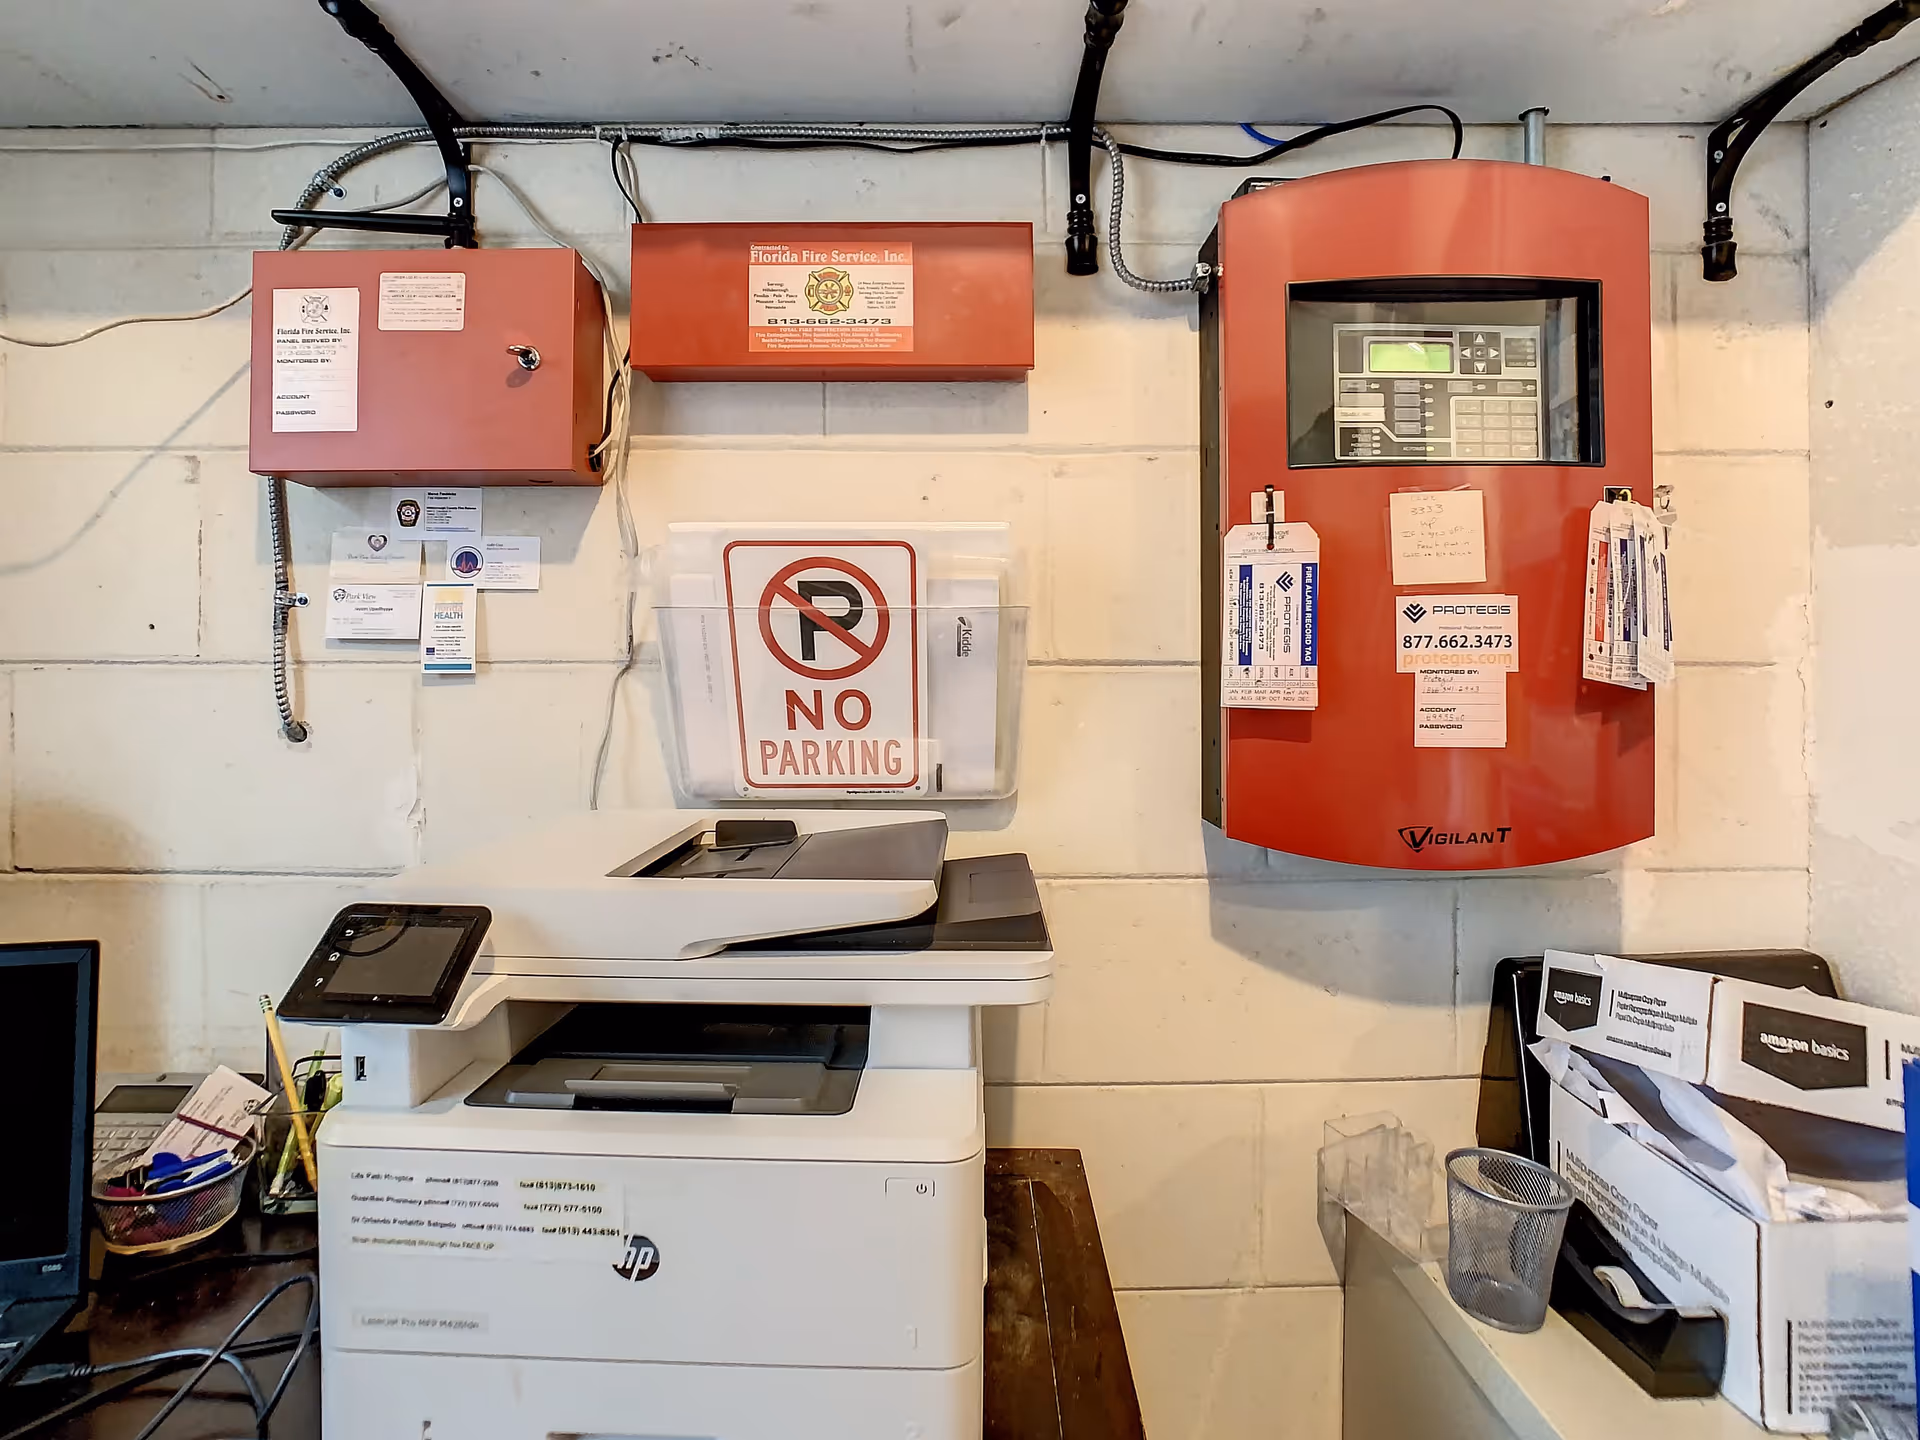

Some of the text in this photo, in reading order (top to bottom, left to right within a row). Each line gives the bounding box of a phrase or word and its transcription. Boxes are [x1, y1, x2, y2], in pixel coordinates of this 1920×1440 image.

[750, 250, 798, 263] Florida
[802, 250, 828, 263] Fire
[831, 250, 880, 263] Service,
[1432, 605, 1510, 615] PROTEGIS
[962, 628, 973, 657] Kidde
[1403, 635, 1512, 649] 877.662.3473
[1304, 646, 1312, 661] TAG
[1403, 653, 1512, 668] protegis.com
[784, 689, 872, 731] NO
[760, 740, 902, 776] PARKING
[1400, 826, 1512, 852] VIGILANT
[1554, 990, 1592, 1006] amazon basics
[1618, 990, 1667, 1007] Multipurpose Copy Paper
[1665, 1012, 1679, 1022] Usage
[1680, 1014, 1697, 1025] Multiple
[1760, 1032, 1850, 1061] amazon basics
[1566, 1148, 1658, 1230] Multipurpose Copy Paper
[540, 1203, 561, 1213] (727)
[1566, 1162, 1730, 1304] Papier Reprographique Usage Multiple
[614, 1235, 658, 1282] hp
